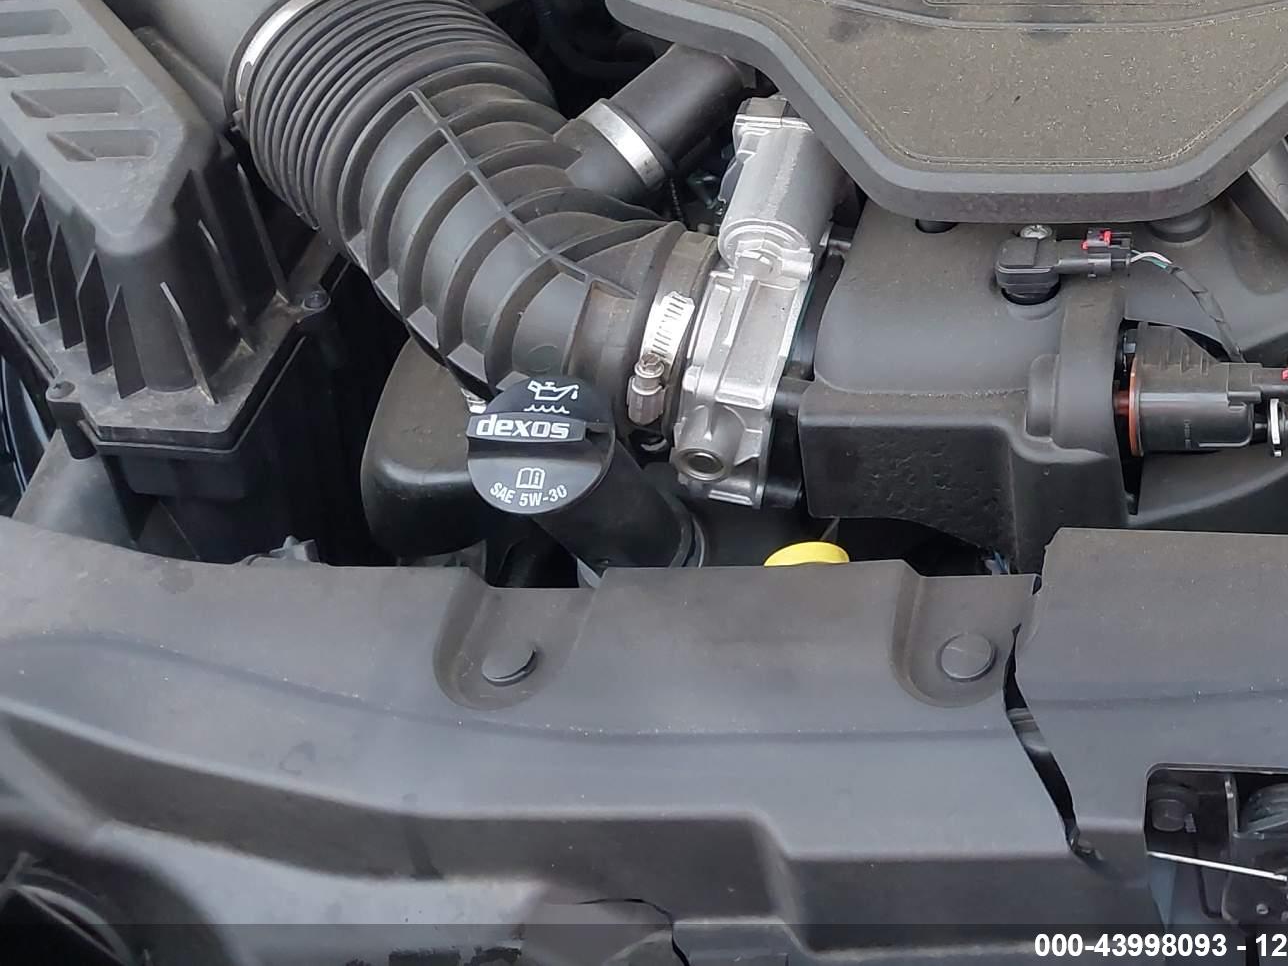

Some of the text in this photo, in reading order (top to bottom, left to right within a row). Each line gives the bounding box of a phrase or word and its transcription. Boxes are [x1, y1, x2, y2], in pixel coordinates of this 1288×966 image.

[475, 414, 571, 439] dexos
[489, 482, 568, 507] SAE 5W-30
